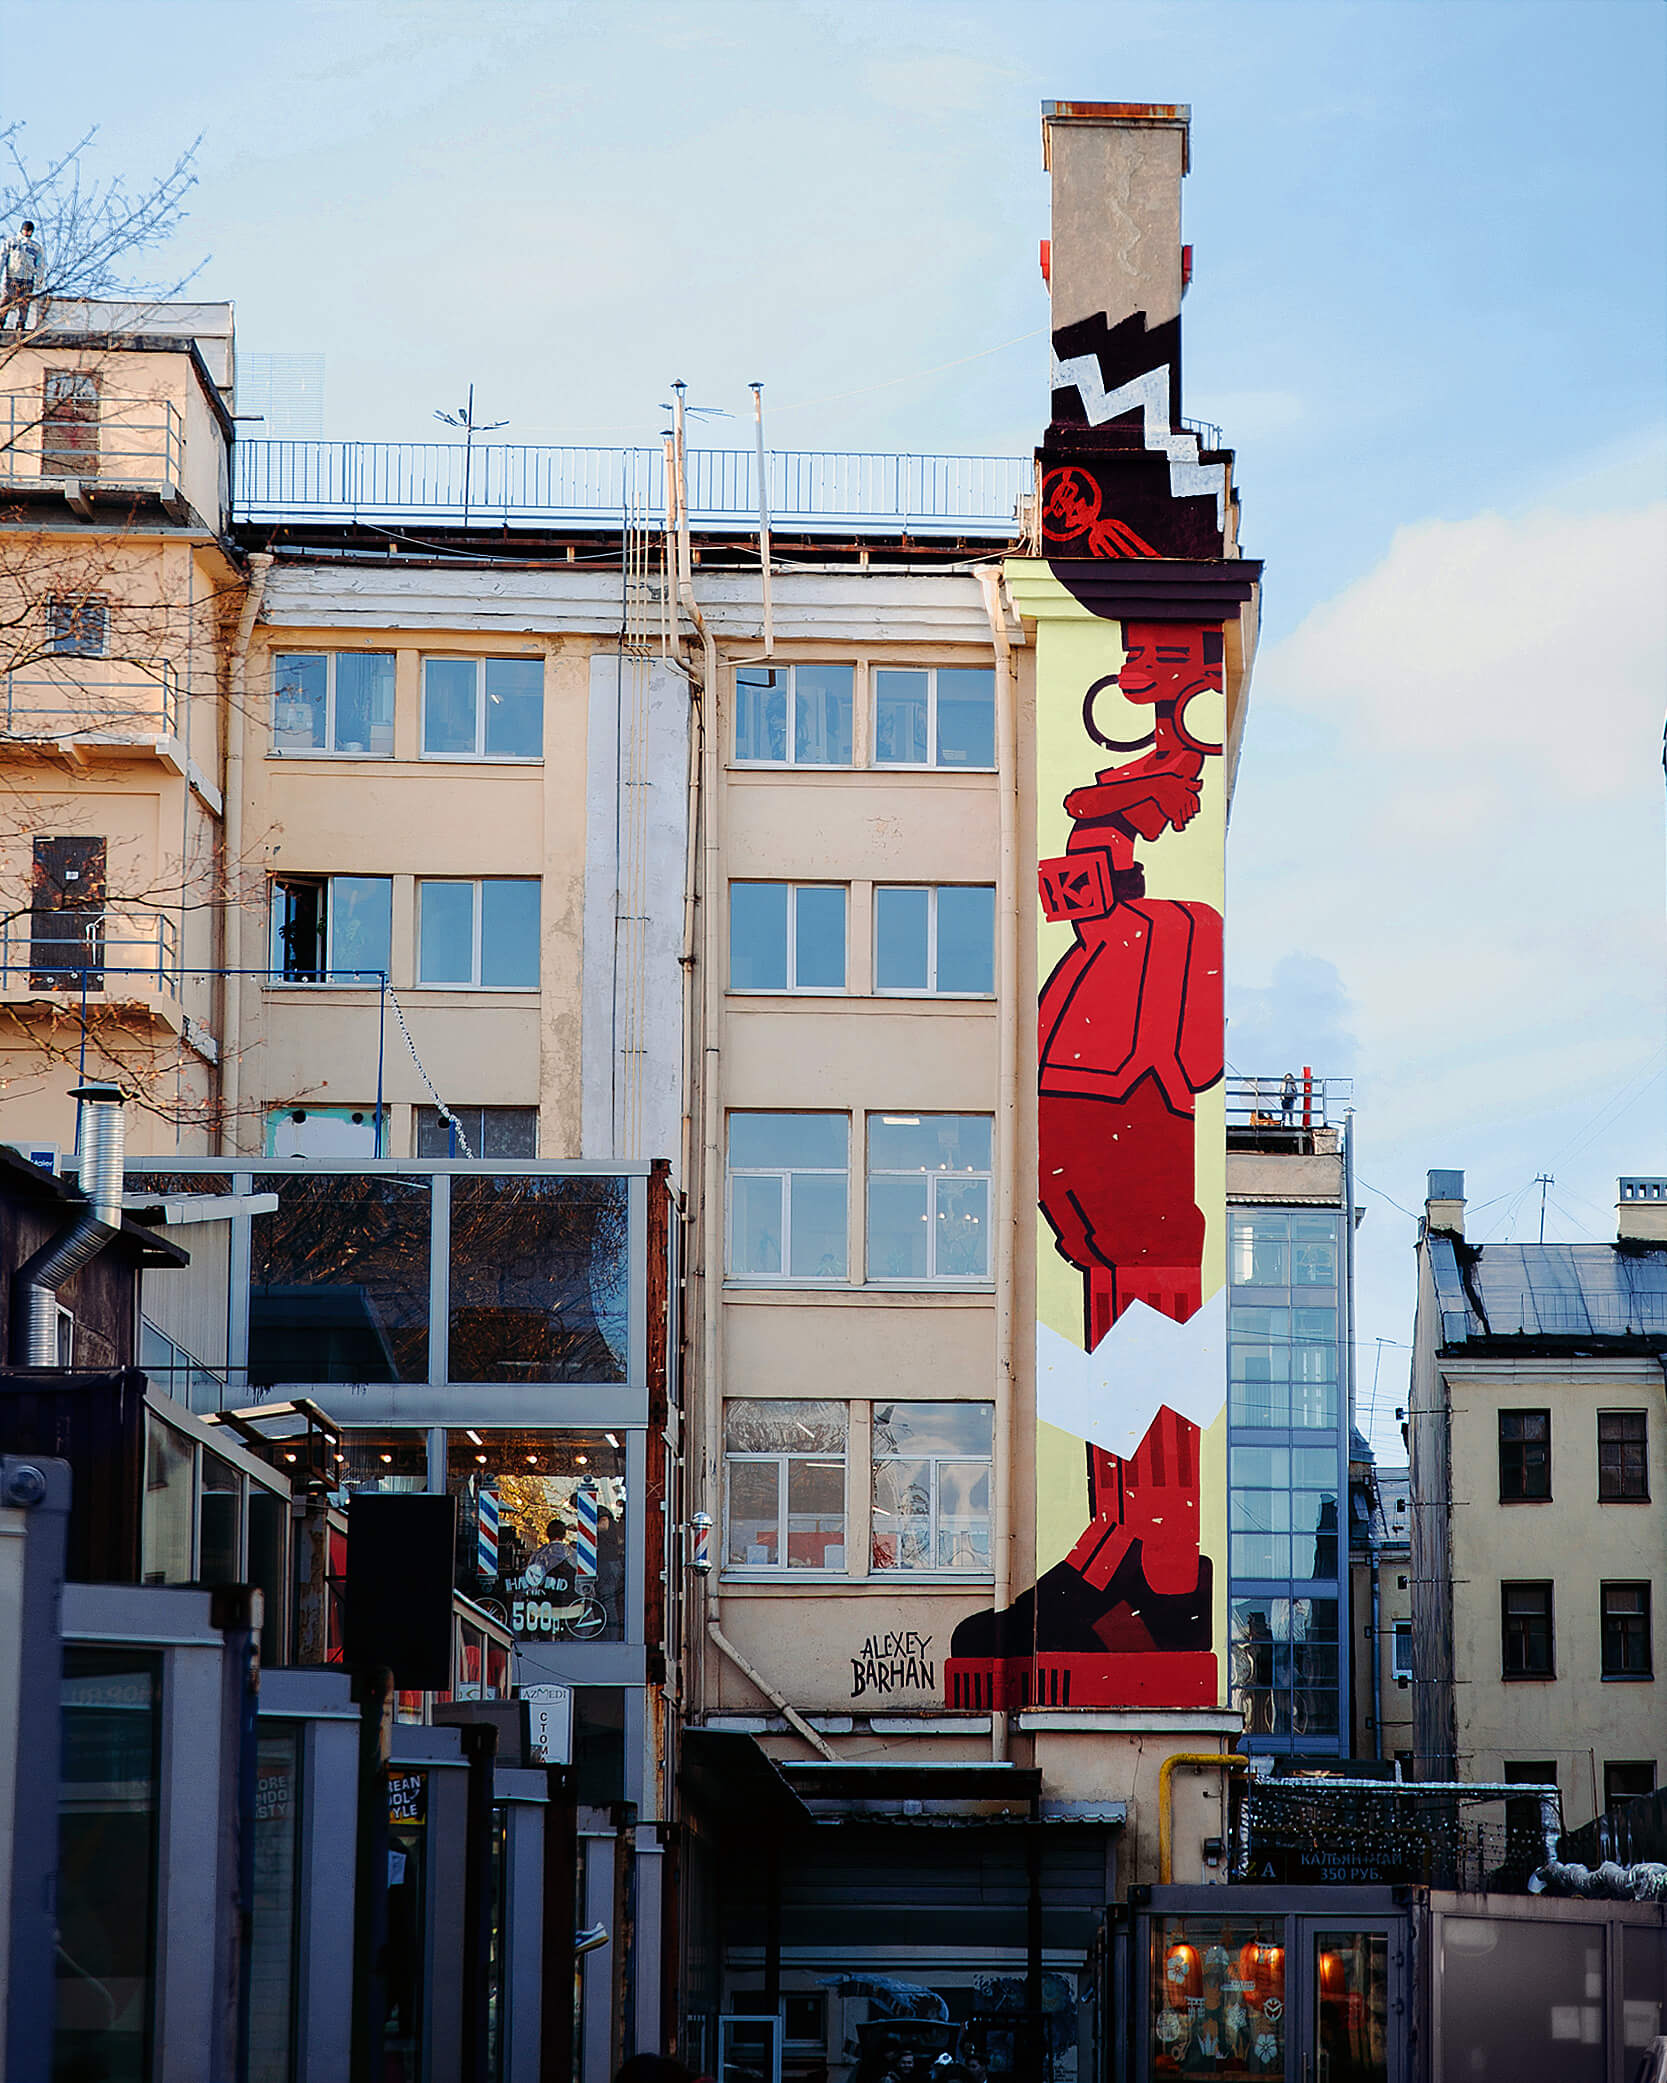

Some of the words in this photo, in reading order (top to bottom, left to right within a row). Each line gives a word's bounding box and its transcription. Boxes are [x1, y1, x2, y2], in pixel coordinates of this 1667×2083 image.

[860, 1631, 933, 1659] ALEXEY
[850, 1656, 935, 1698] BARHAN
[523, 1687, 567, 1699] AZMEDI
[1320, 1867, 1347, 1881] 350
[1350, 1867, 1383, 1881] РУБ.
